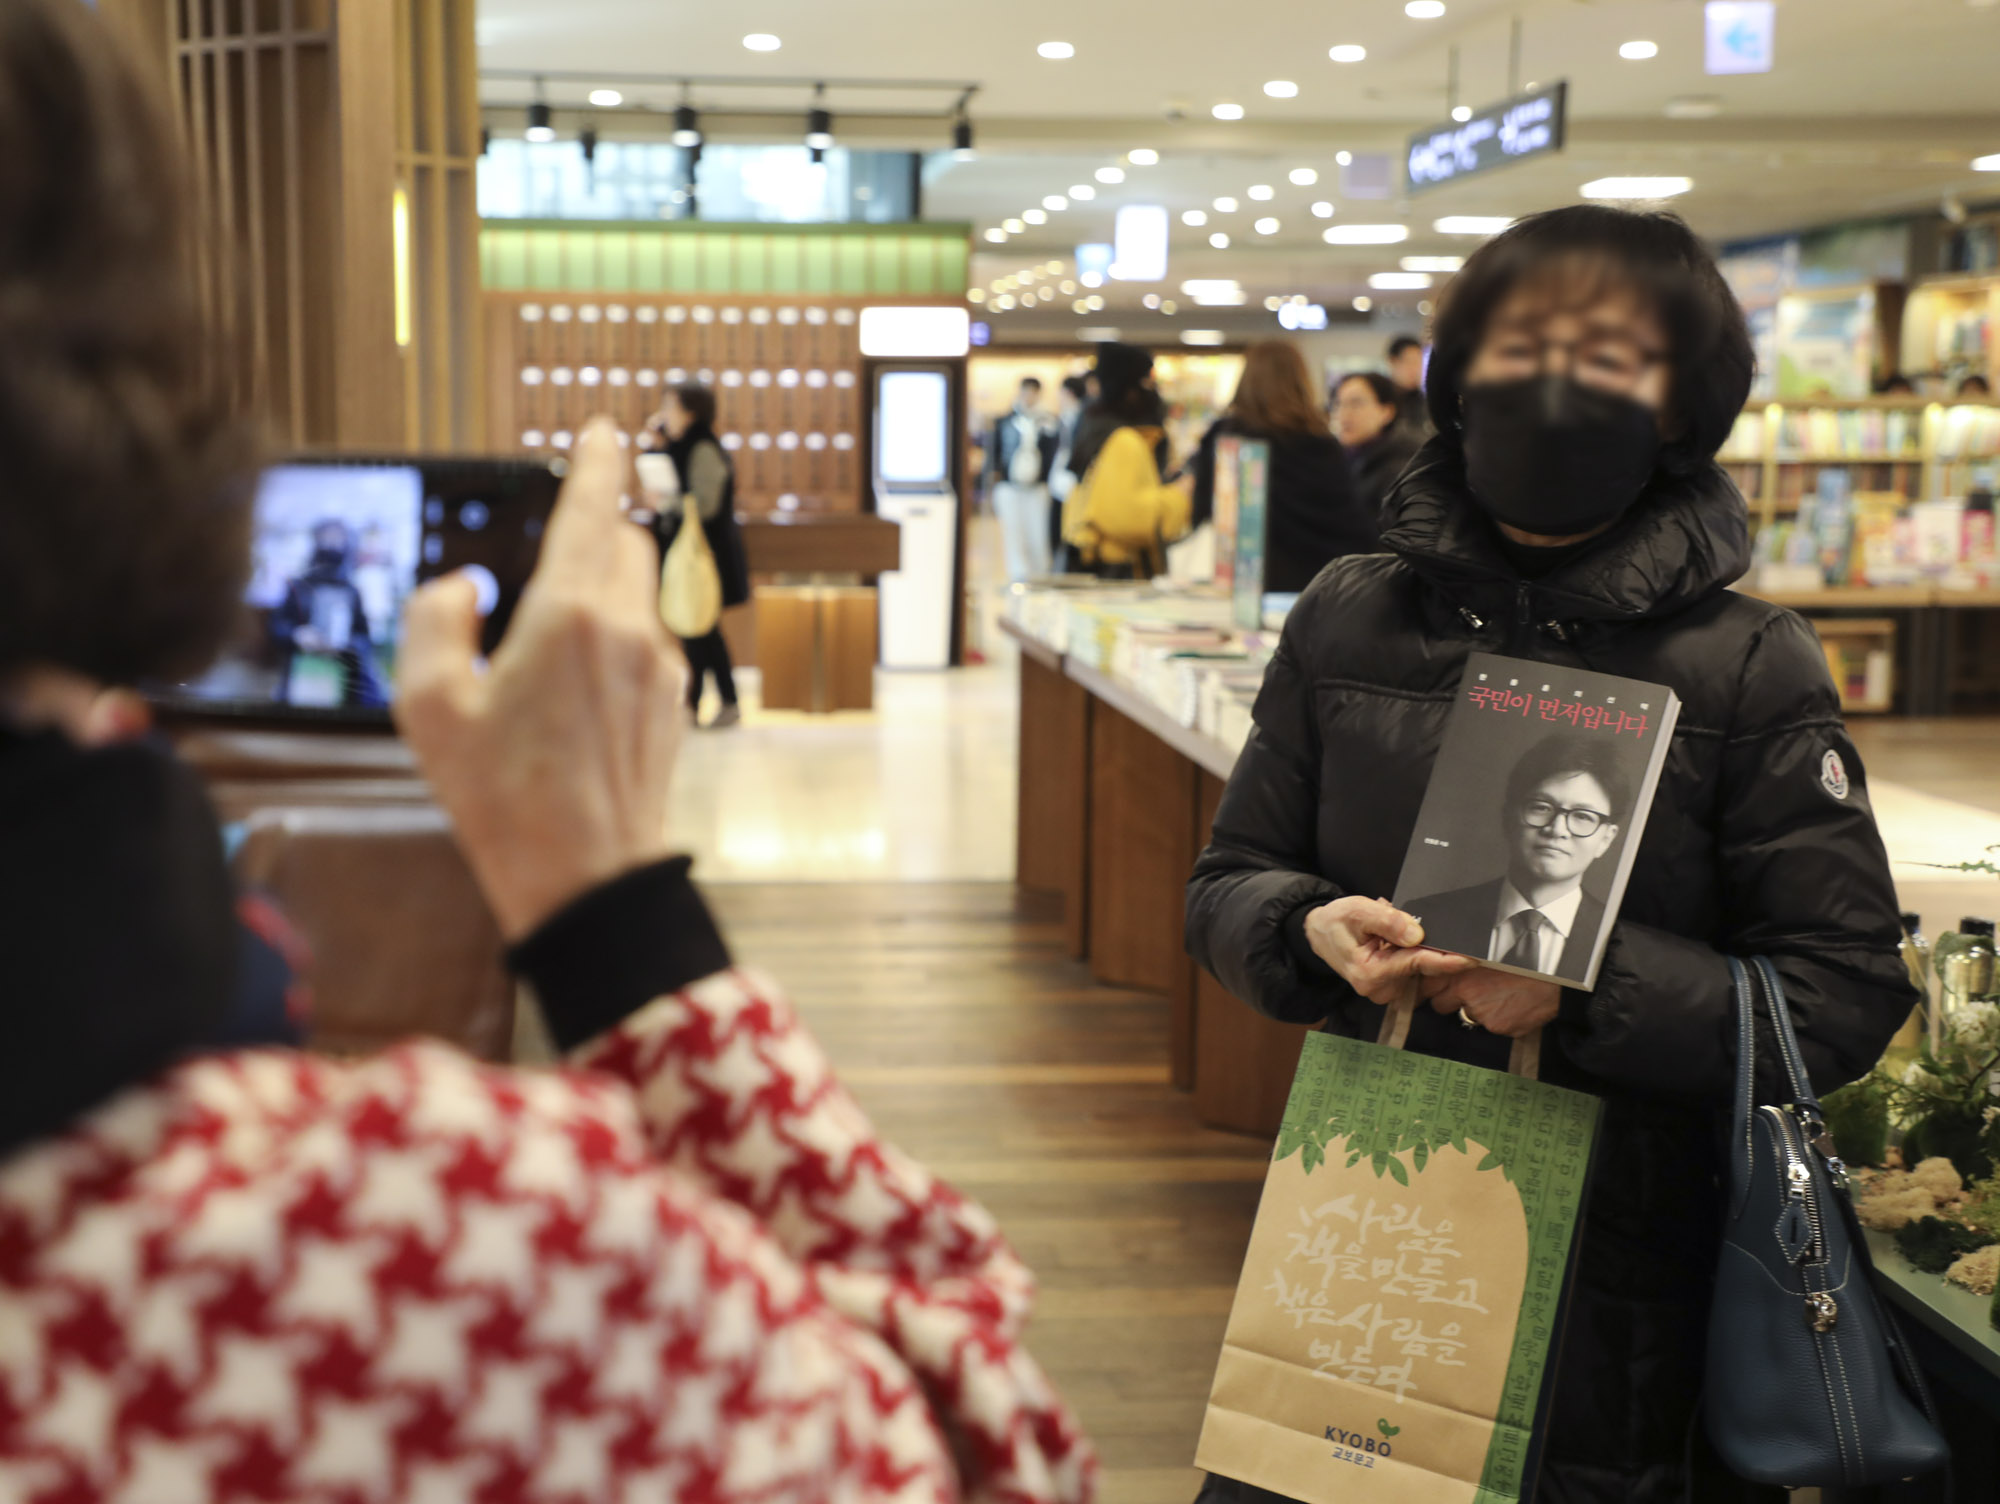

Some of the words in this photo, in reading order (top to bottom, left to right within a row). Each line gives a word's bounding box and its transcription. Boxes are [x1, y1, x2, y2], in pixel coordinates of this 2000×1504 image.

[1468, 686, 1533, 717] 국민이
[1538, 698, 1649, 739] 먼저입니다
[1311, 1194, 1462, 1258] 사람은
[1284, 1205, 1368, 1289] 책을
[1372, 1252, 1489, 1315] 만들고
[1263, 1268, 1340, 1329] 책은
[1337, 1303, 1467, 1367] 사람을
[1307, 1338, 1418, 1404] 만든다
[1324, 1425, 1392, 1457] KYOBO
[1331, 1446, 1376, 1469] 교보문고
